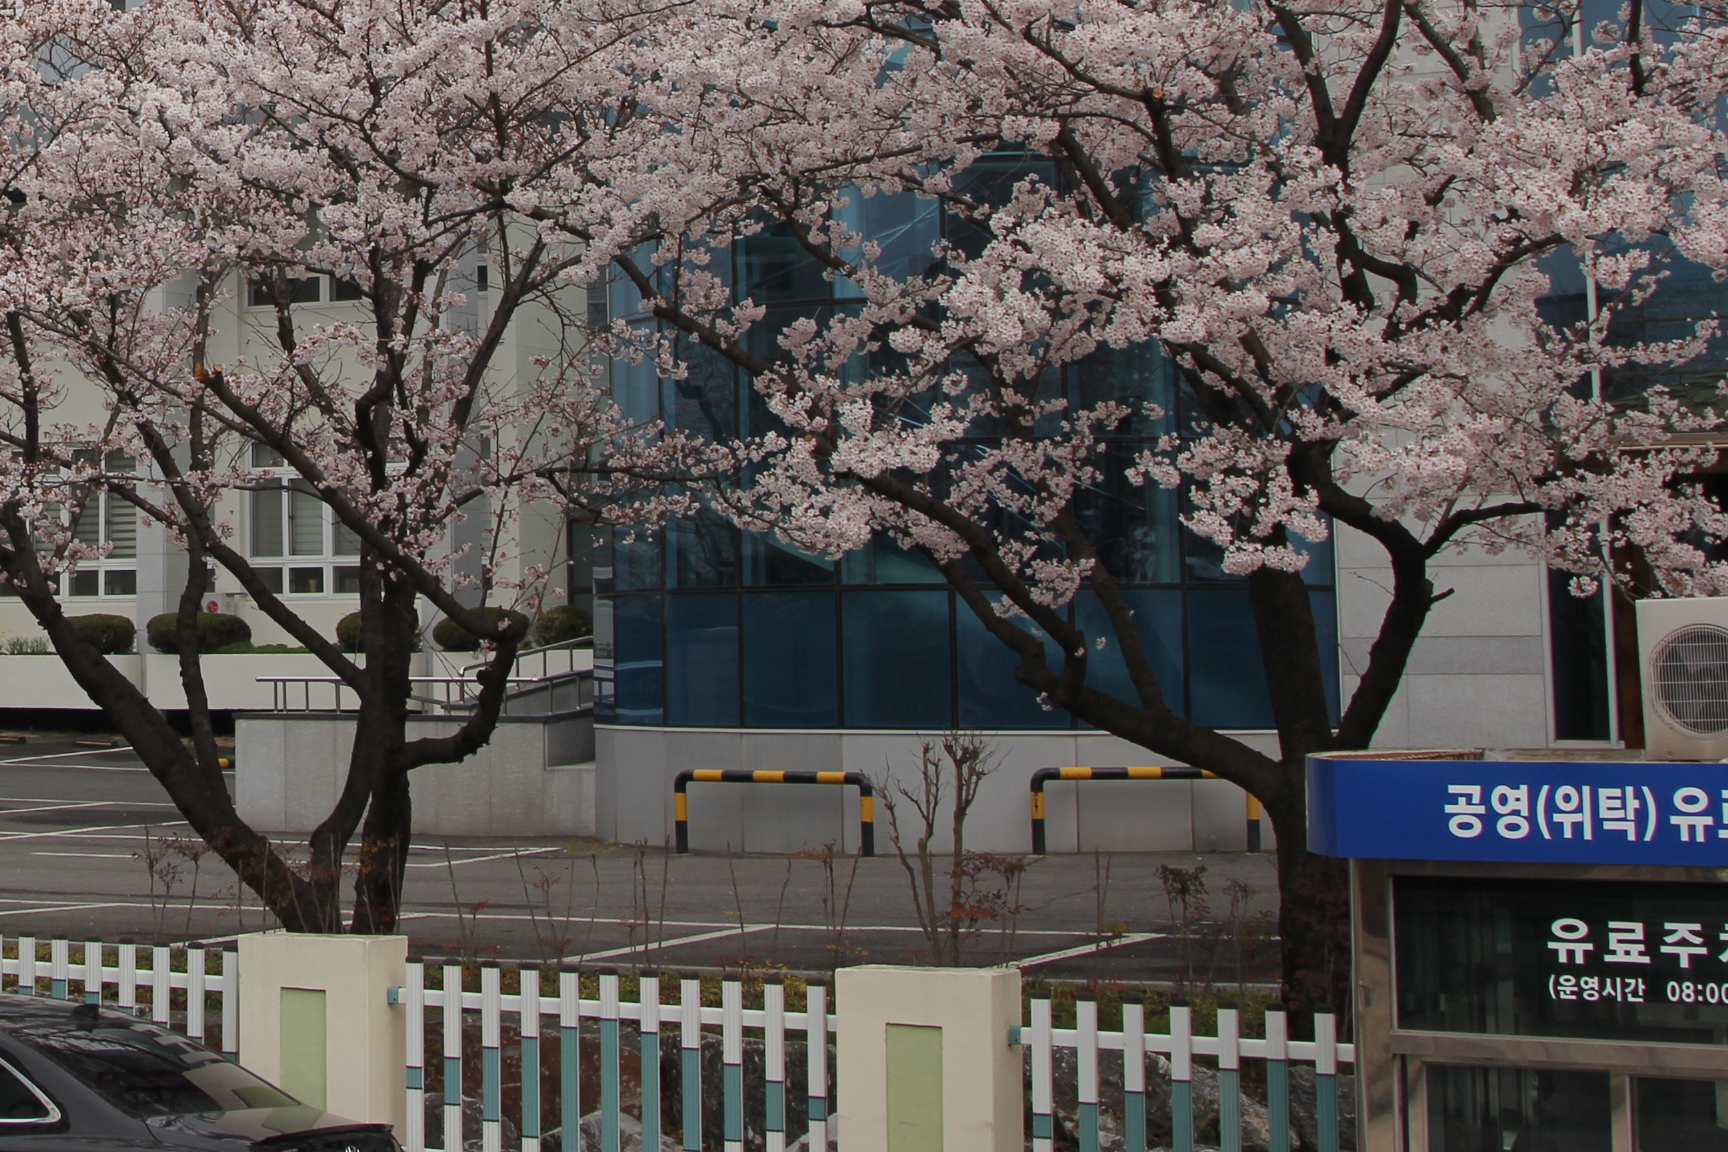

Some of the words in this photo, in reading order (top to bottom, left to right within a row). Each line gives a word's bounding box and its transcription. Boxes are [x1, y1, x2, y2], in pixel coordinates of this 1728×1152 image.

[1444, 784, 1657, 842] 공영(위탁)
[1670, 786, 1728, 843] 유
[1547, 917, 1728, 969] 유료주
[1548, 974, 1646, 1003] (운영시간
